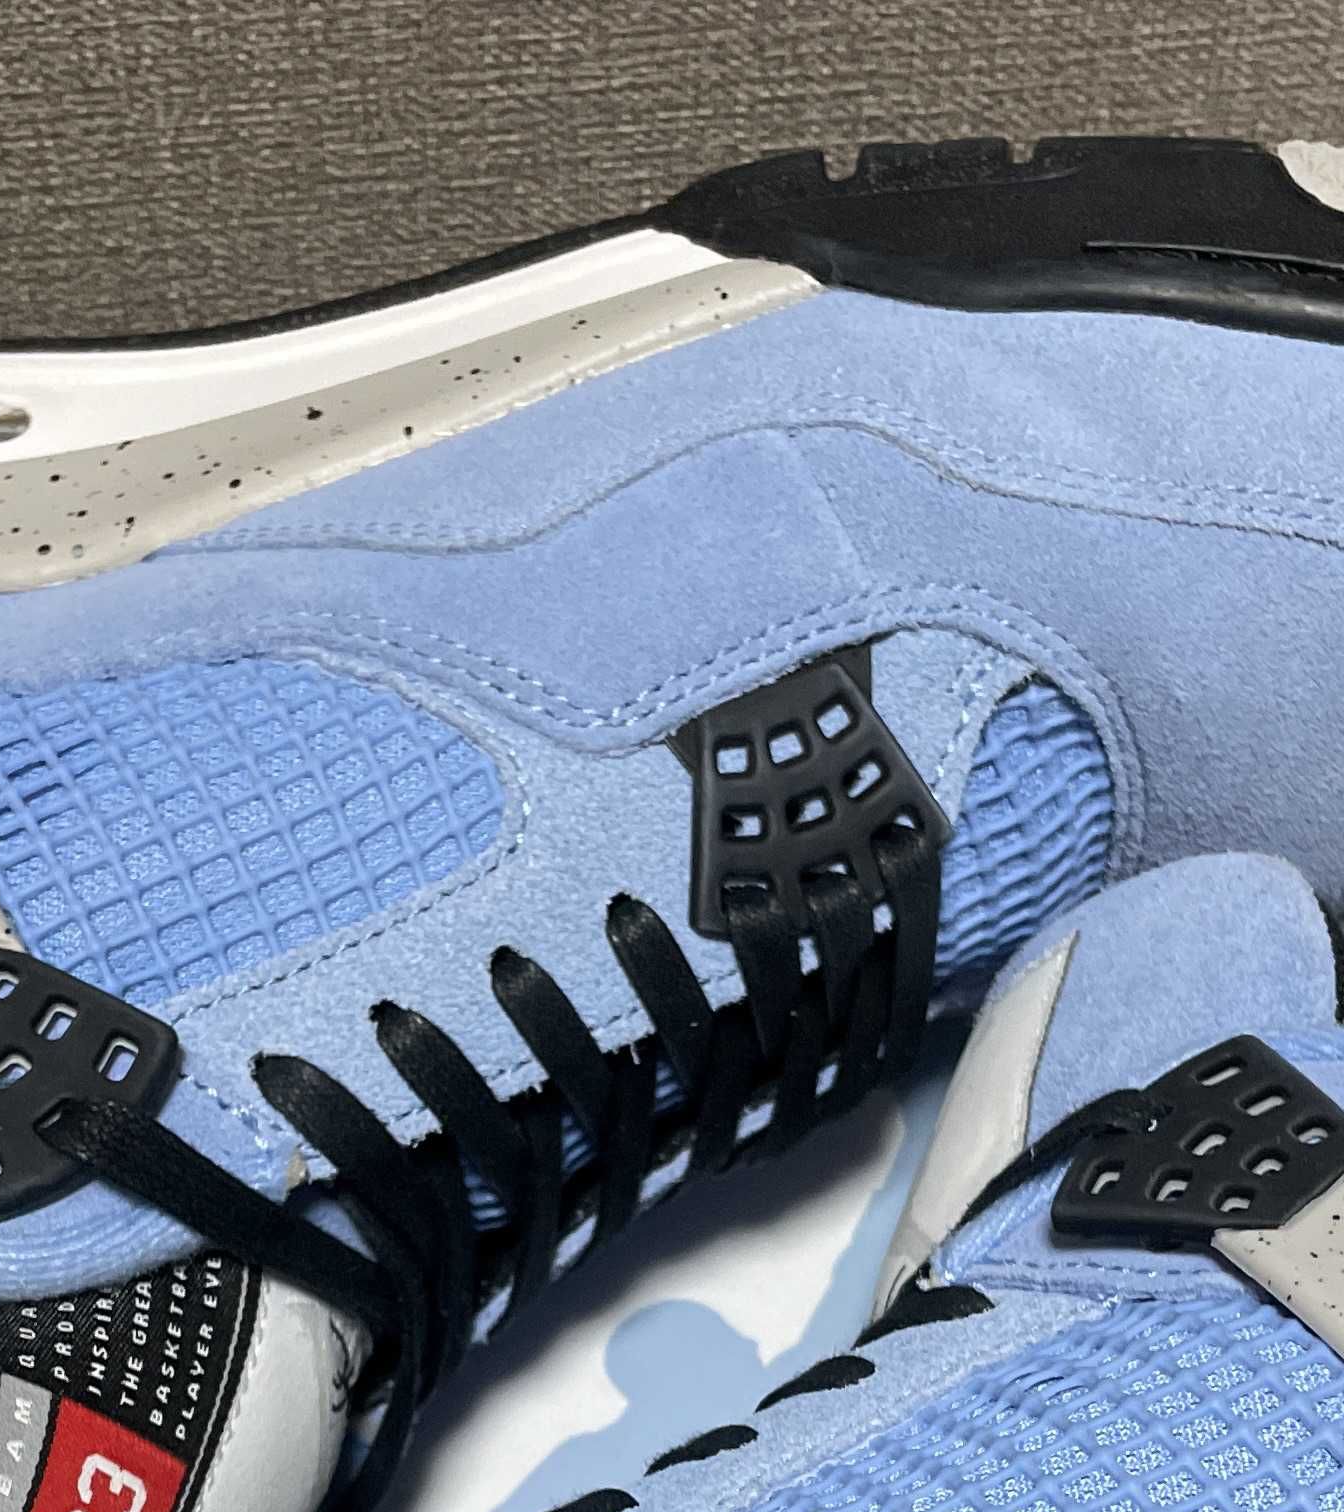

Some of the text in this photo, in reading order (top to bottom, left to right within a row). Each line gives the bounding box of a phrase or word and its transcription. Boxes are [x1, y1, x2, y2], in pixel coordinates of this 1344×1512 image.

[18, 1306, 37, 1369] QUA
[53, 1301, 75, 1383] PROD
[87, 1289, 116, 1397] INSPIR
[120, 1280, 153, 1407] THE GREA
[149, 1266, 188, 1427] BASKETBA
[174, 1256, 223, 1441] PLAYER EVE
